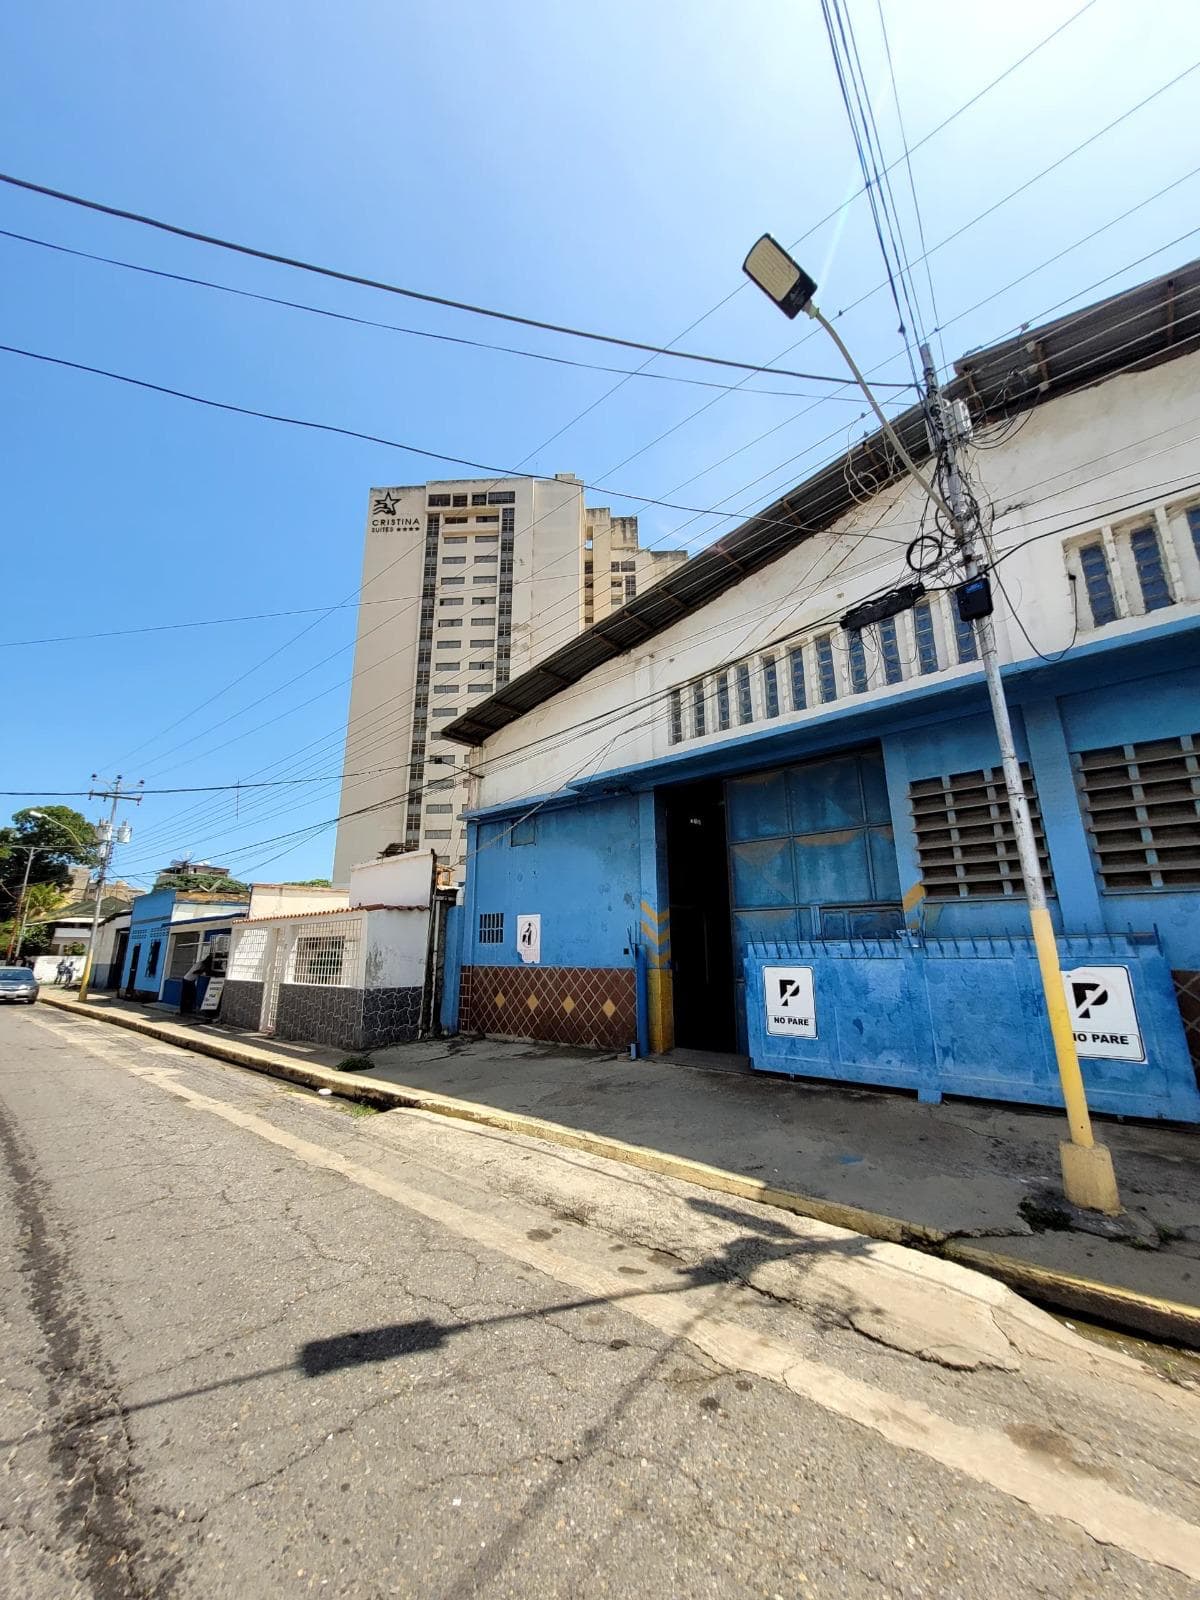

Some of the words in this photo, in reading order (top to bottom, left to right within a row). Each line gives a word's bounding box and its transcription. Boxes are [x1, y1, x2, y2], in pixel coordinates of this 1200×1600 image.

[372, 518, 420, 526] CRISTINA
[787, 1017, 810, 1026] PARE
[1091, 1034, 1130, 1045] PARE
